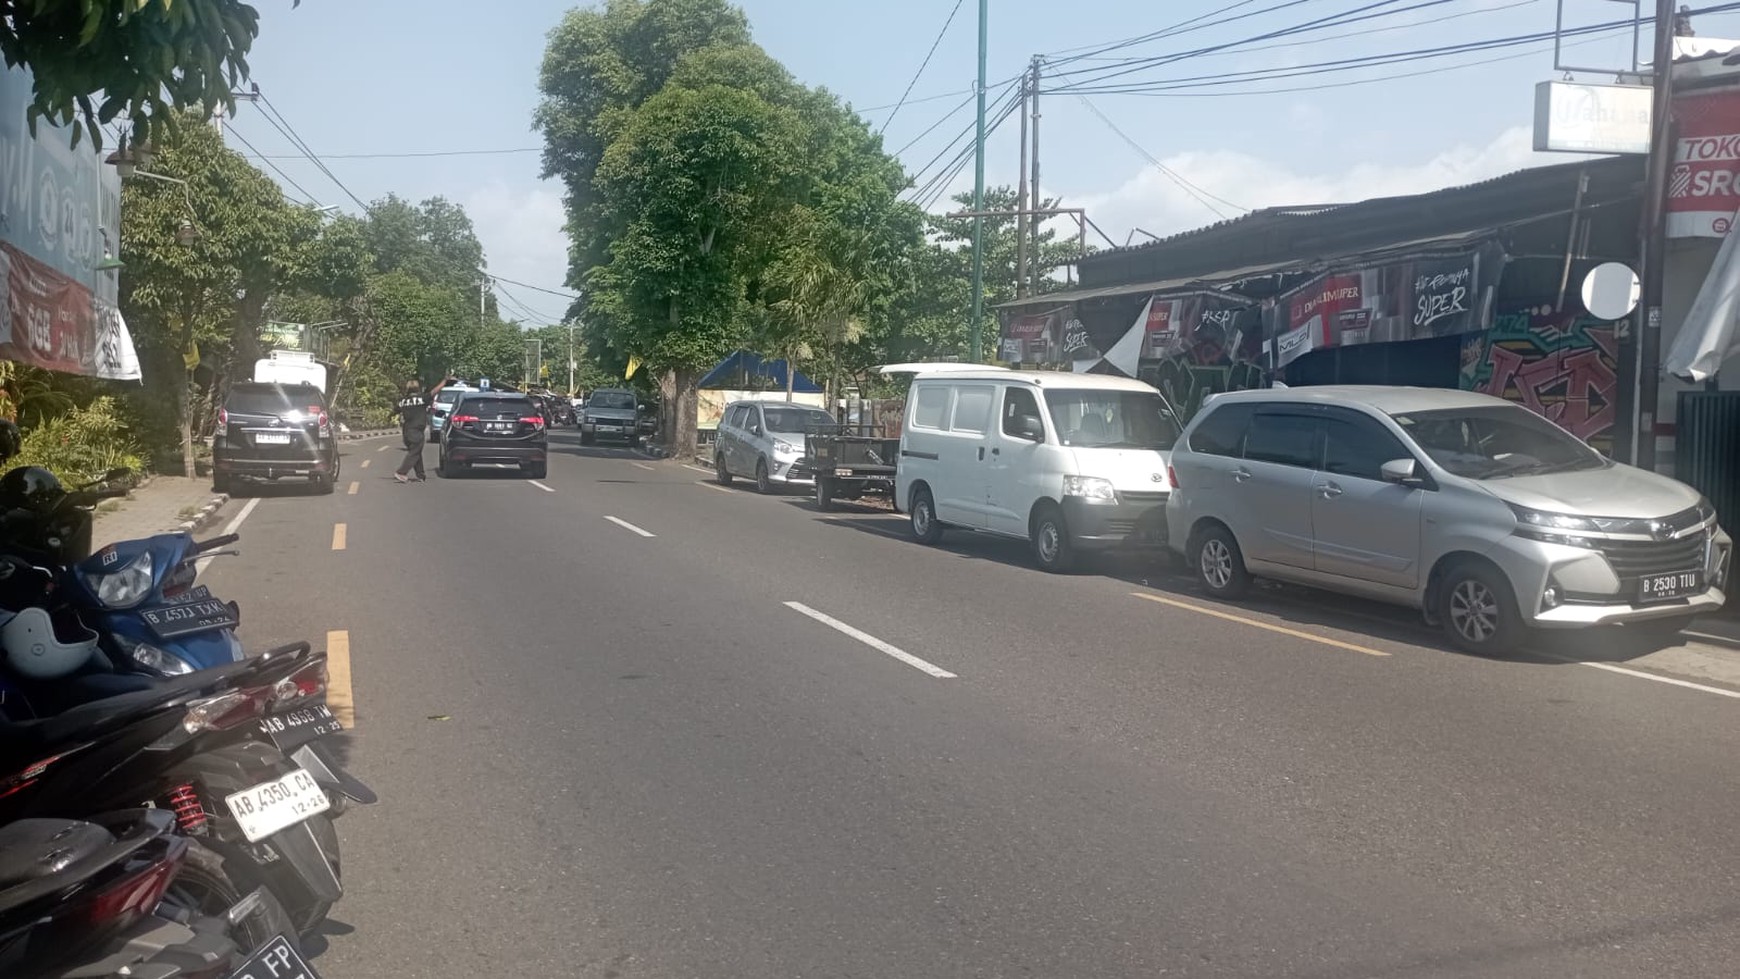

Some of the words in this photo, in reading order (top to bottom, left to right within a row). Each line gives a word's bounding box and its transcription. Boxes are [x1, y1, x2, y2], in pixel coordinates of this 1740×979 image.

[1414, 286, 1467, 325] SUPER
[1643, 579, 1650, 593] B
[1653, 576, 1677, 592] 2530
[1680, 573, 1695, 588] TIU
[147, 611, 160, 624] B
[267, 716, 285, 734] AB
[286, 708, 315, 728] 4968
[233, 795, 255, 819] AB
[294, 772, 315, 792] CA
[262, 944, 291, 978] FP
